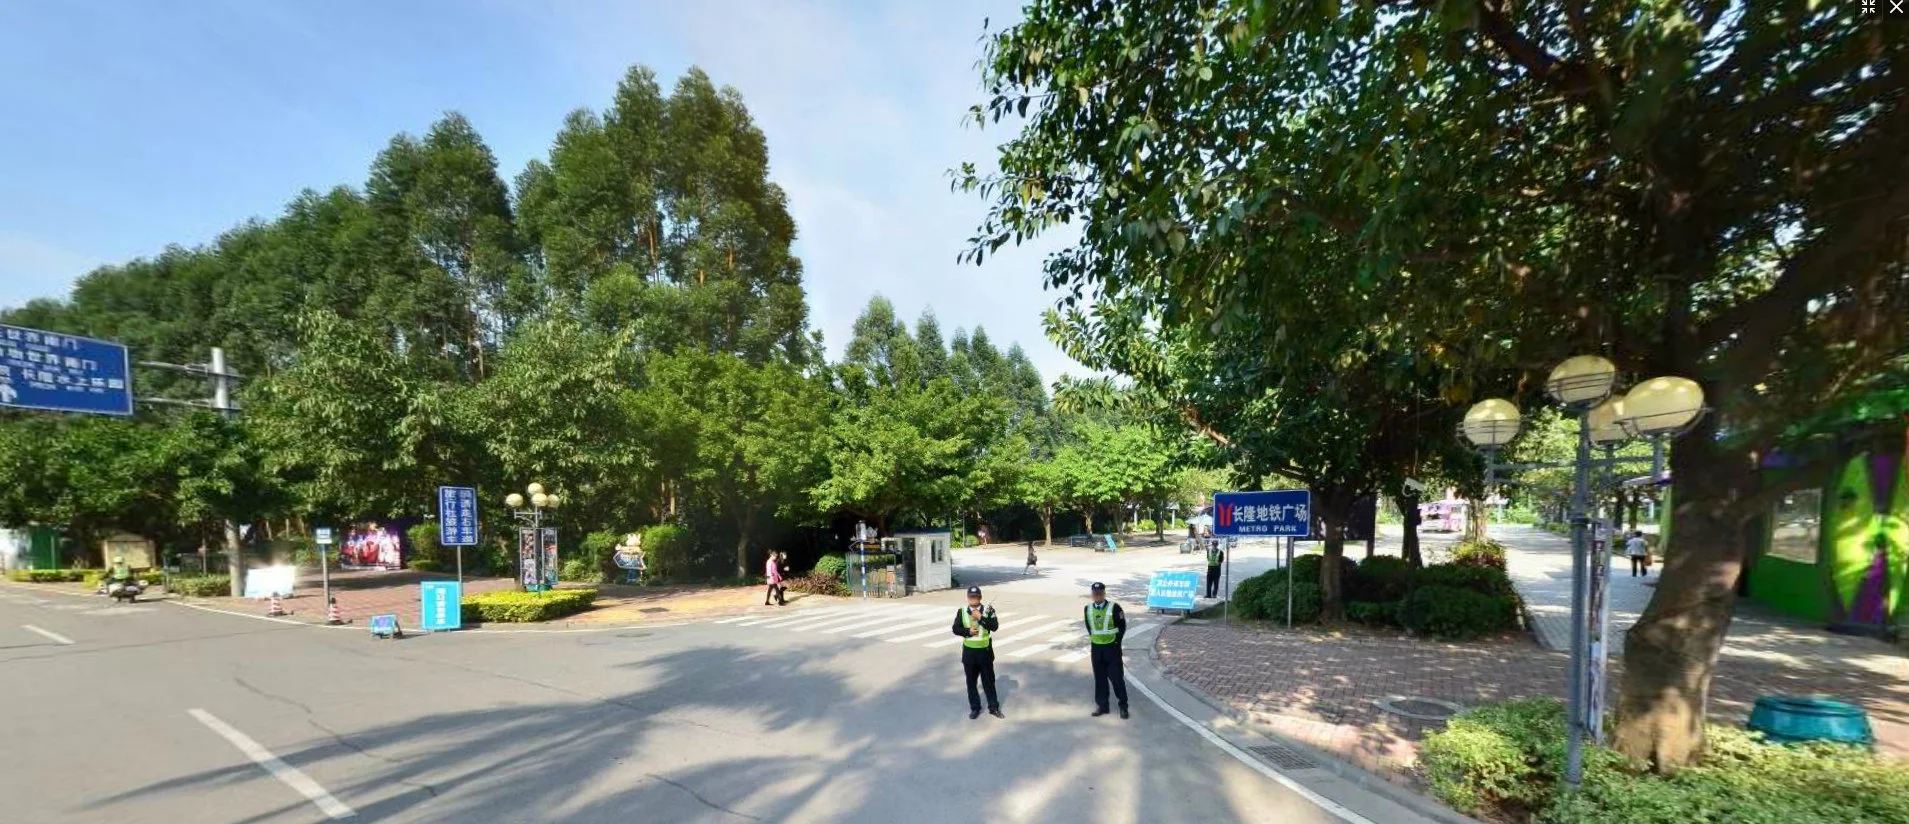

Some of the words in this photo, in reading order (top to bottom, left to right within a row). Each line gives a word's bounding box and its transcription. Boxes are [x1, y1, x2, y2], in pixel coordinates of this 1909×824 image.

[1232, 504, 1307, 522] 长隆地铁广场
